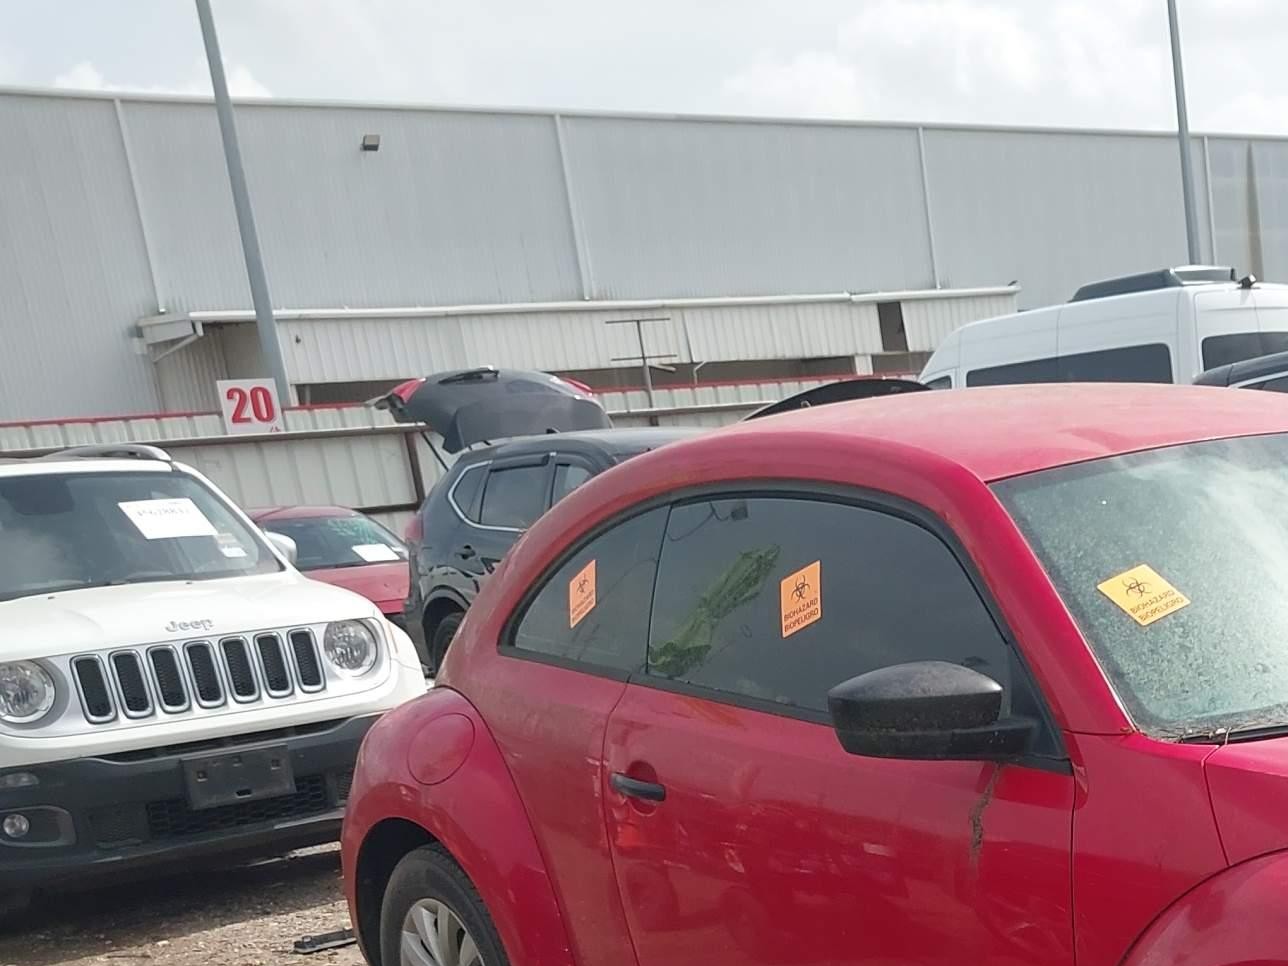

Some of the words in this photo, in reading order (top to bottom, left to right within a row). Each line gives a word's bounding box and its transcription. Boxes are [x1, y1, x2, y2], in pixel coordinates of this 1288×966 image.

[226, 386, 275, 424] 20
[783, 597, 818, 622] BIOHAZARD
[165, 618, 214, 633] Jeep
